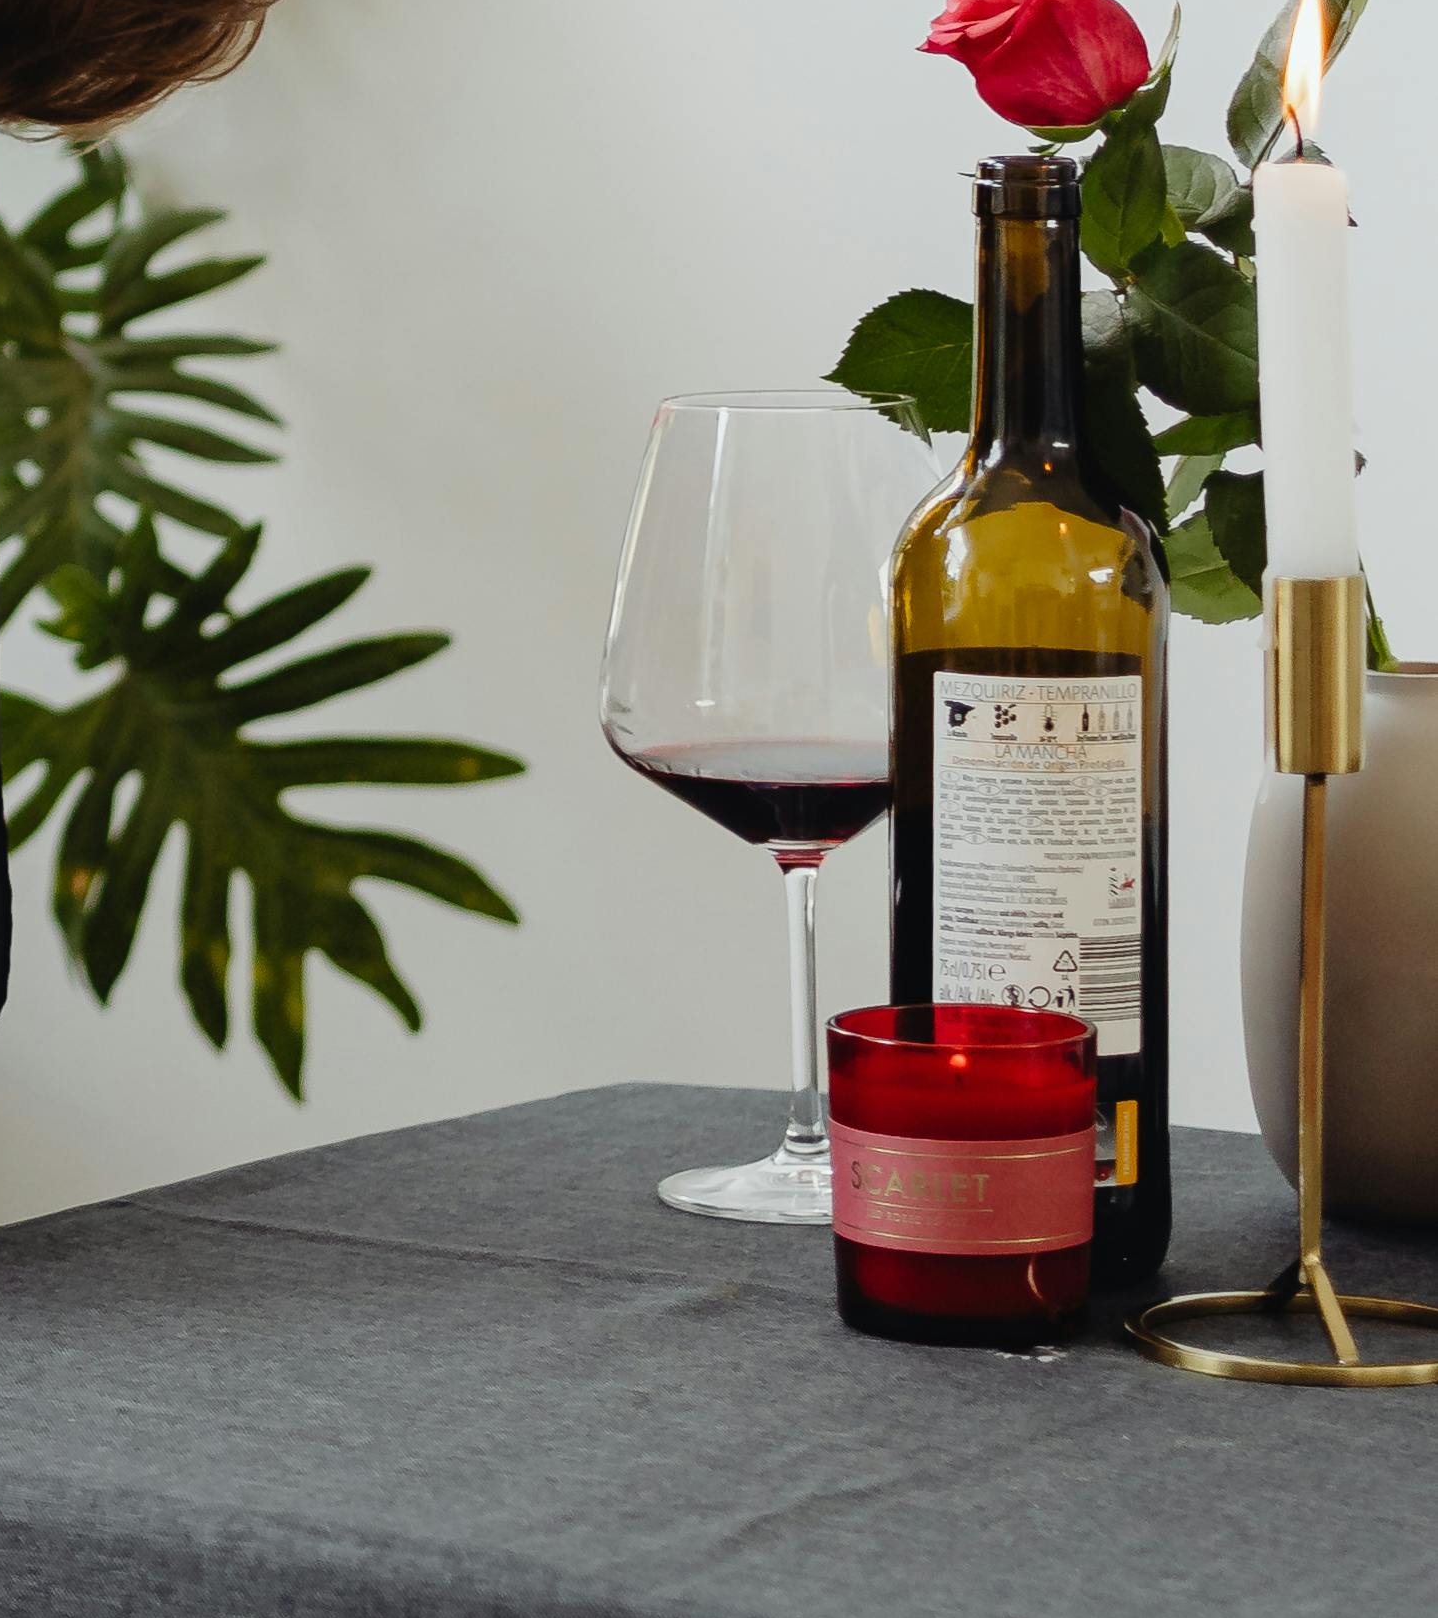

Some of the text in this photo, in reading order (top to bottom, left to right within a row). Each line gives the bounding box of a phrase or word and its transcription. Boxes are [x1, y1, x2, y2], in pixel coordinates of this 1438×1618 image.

[940, 681, 1026, 700] MEZQUIRIZ
[1037, 683, 1137, 700] TEMPRANILLO
[995, 745, 1088, 760] LA MANCHA
[851, 1160, 990, 1202] SCARLET
